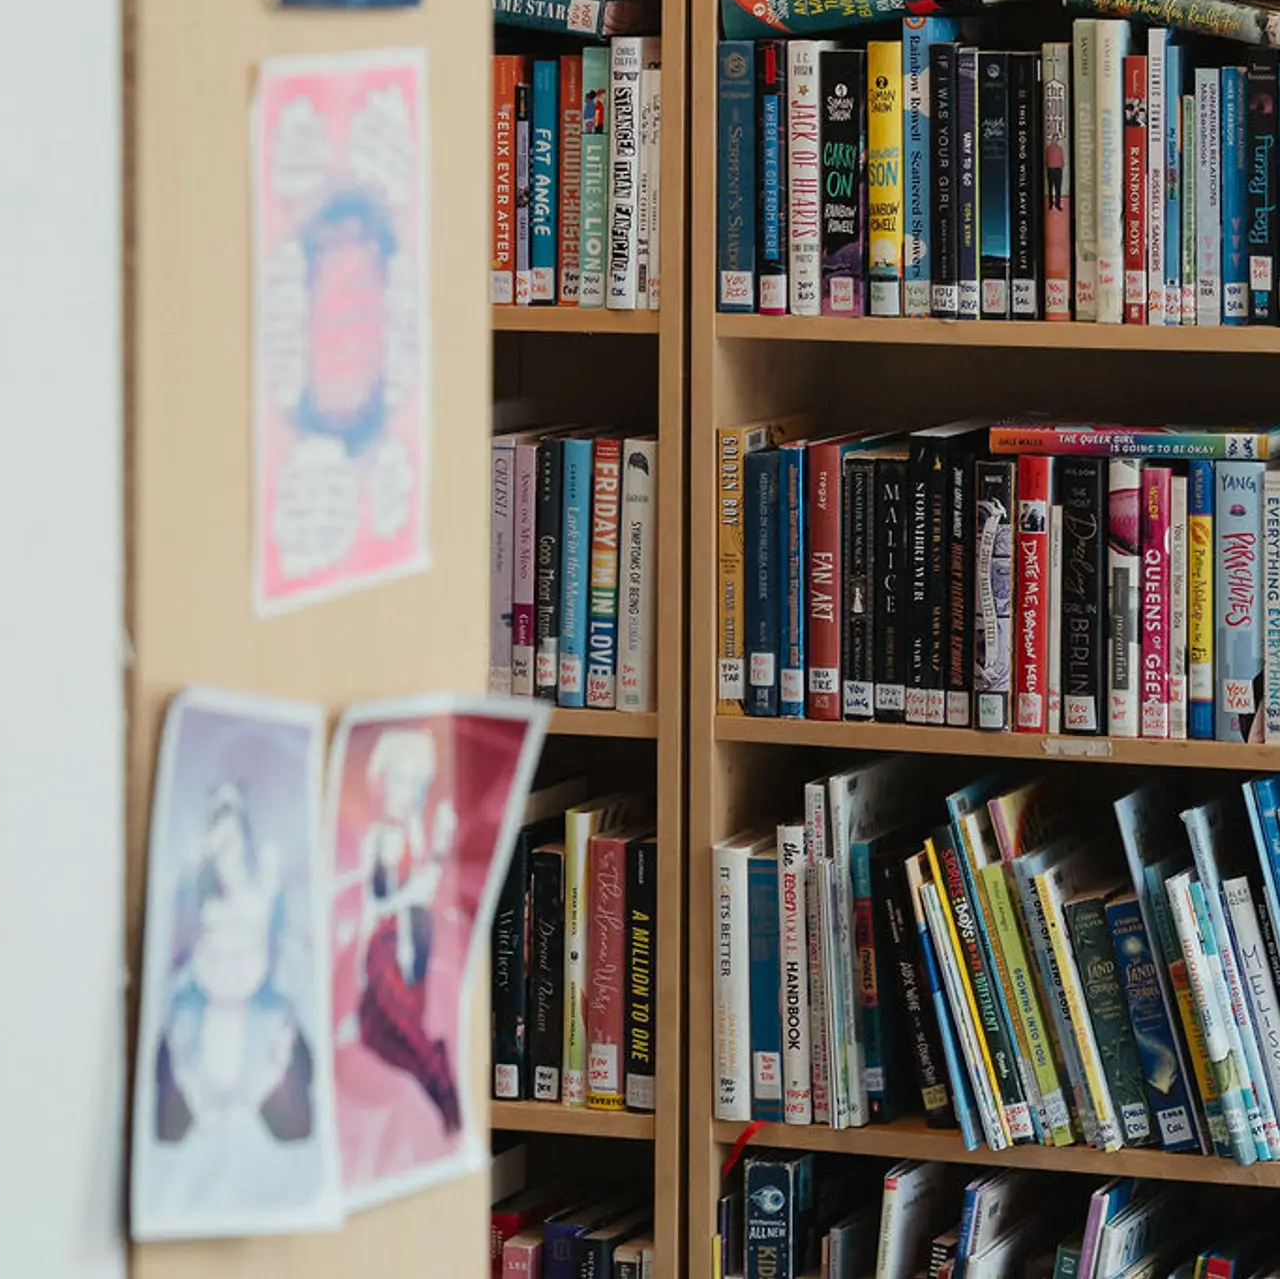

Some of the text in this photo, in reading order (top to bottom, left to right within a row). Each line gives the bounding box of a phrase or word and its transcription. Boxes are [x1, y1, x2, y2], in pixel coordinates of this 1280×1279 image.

[612, 86, 635, 198] STRANGER THAN
[910, 34, 922, 142] Rainbow Rowell
[496, 110, 510, 262] FELIX EVER AFTER
[792, 100, 820, 238] JACK OF HEARTS
[910, 149, 924, 280] Scattered Showers
[1129, 145, 1141, 256] RAINBOW BOYS
[722, 436, 738, 527] GOLDEN BOY
[1059, 434, 1135, 445] THE QUEER GIRL
[590, 461, 618, 676] FRIDAY I'M IN LOVE
[811, 470, 834, 623] tregay FAN ART
[1222, 532, 1257, 628] PARACHUTES
[1266, 496, 1280, 602] EVERYTHING
[1068, 620, 1090, 696] BERLIN
[720, 866, 732, 978] IT GETS BETTER
[630, 910, 650, 1064] A MILLION TO ONE
